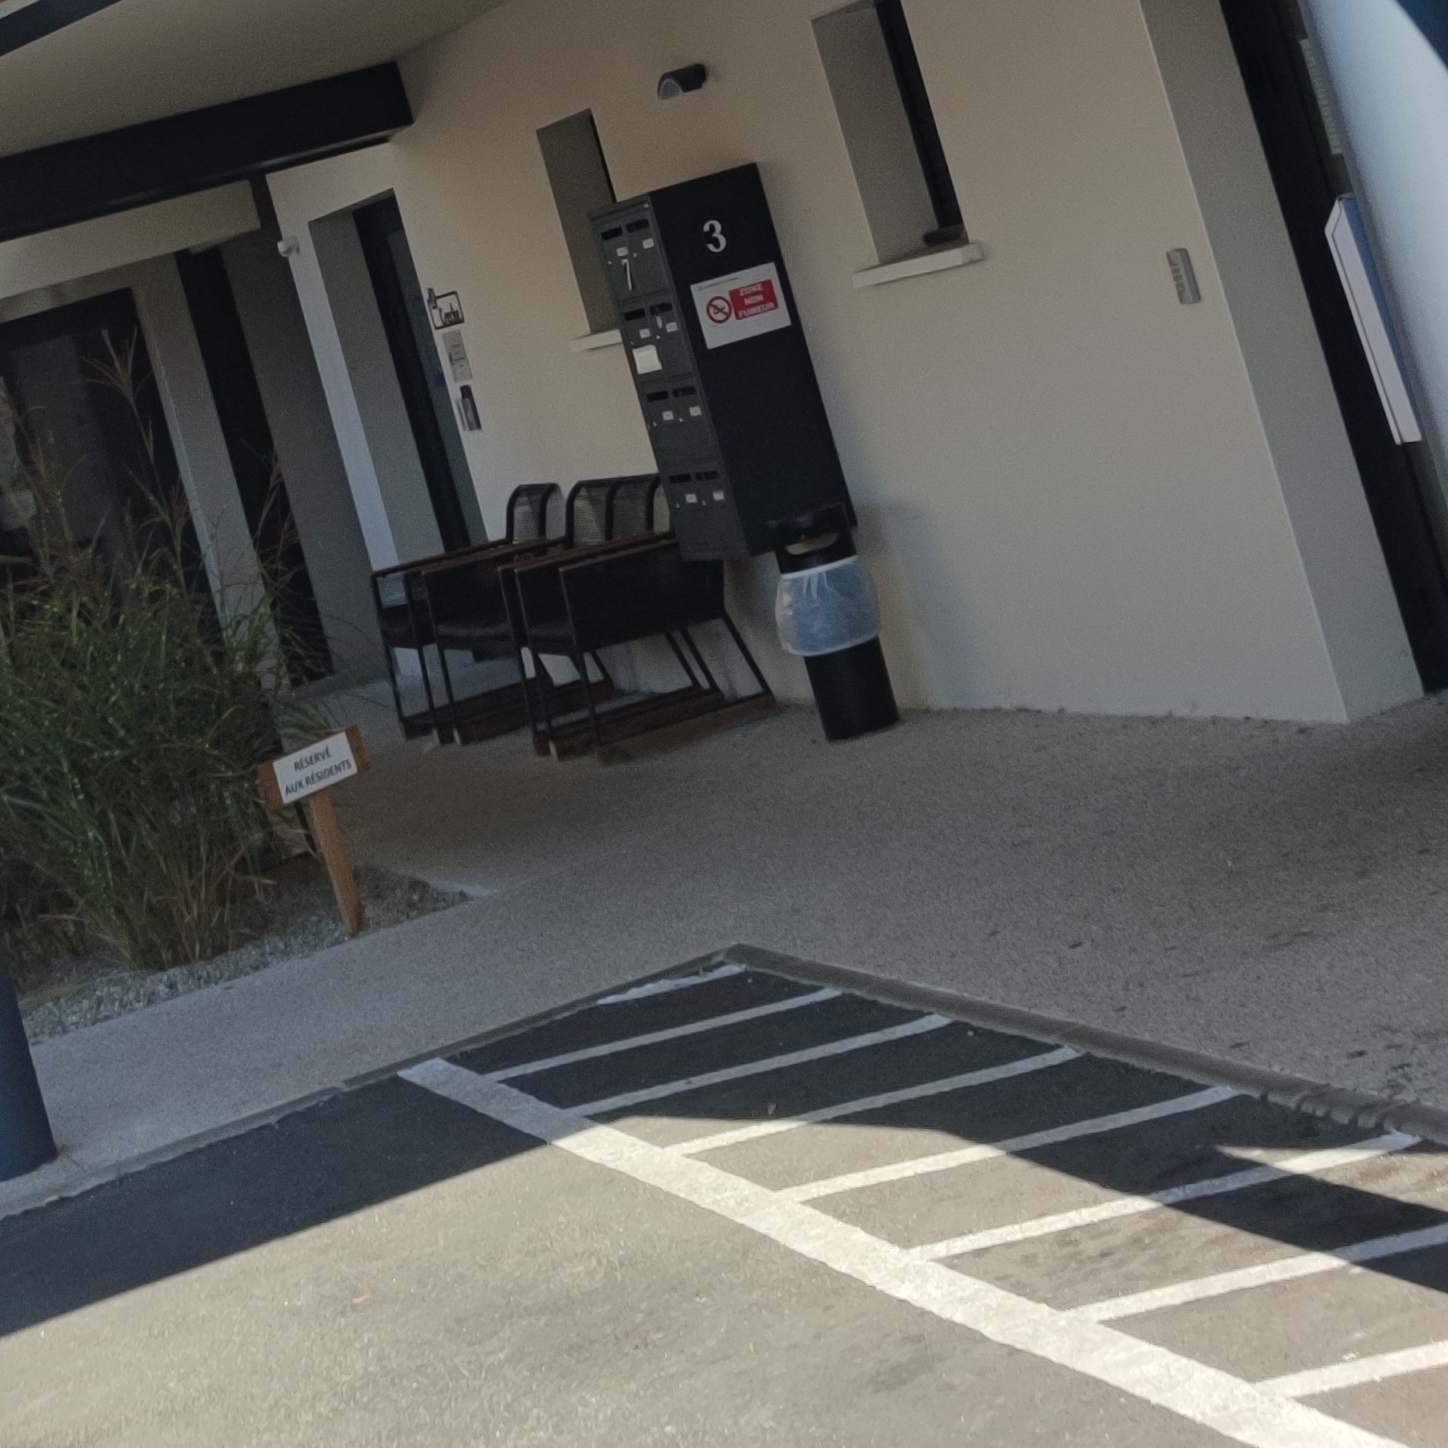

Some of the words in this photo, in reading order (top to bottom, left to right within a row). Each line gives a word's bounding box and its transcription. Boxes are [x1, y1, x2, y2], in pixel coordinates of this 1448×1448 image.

[702, 219, 727, 253] 3
[294, 745, 332, 772] RÉSERVÉ
[285, 780, 304, 797] AUX
[305, 759, 352, 788] RÉSIDENTS
